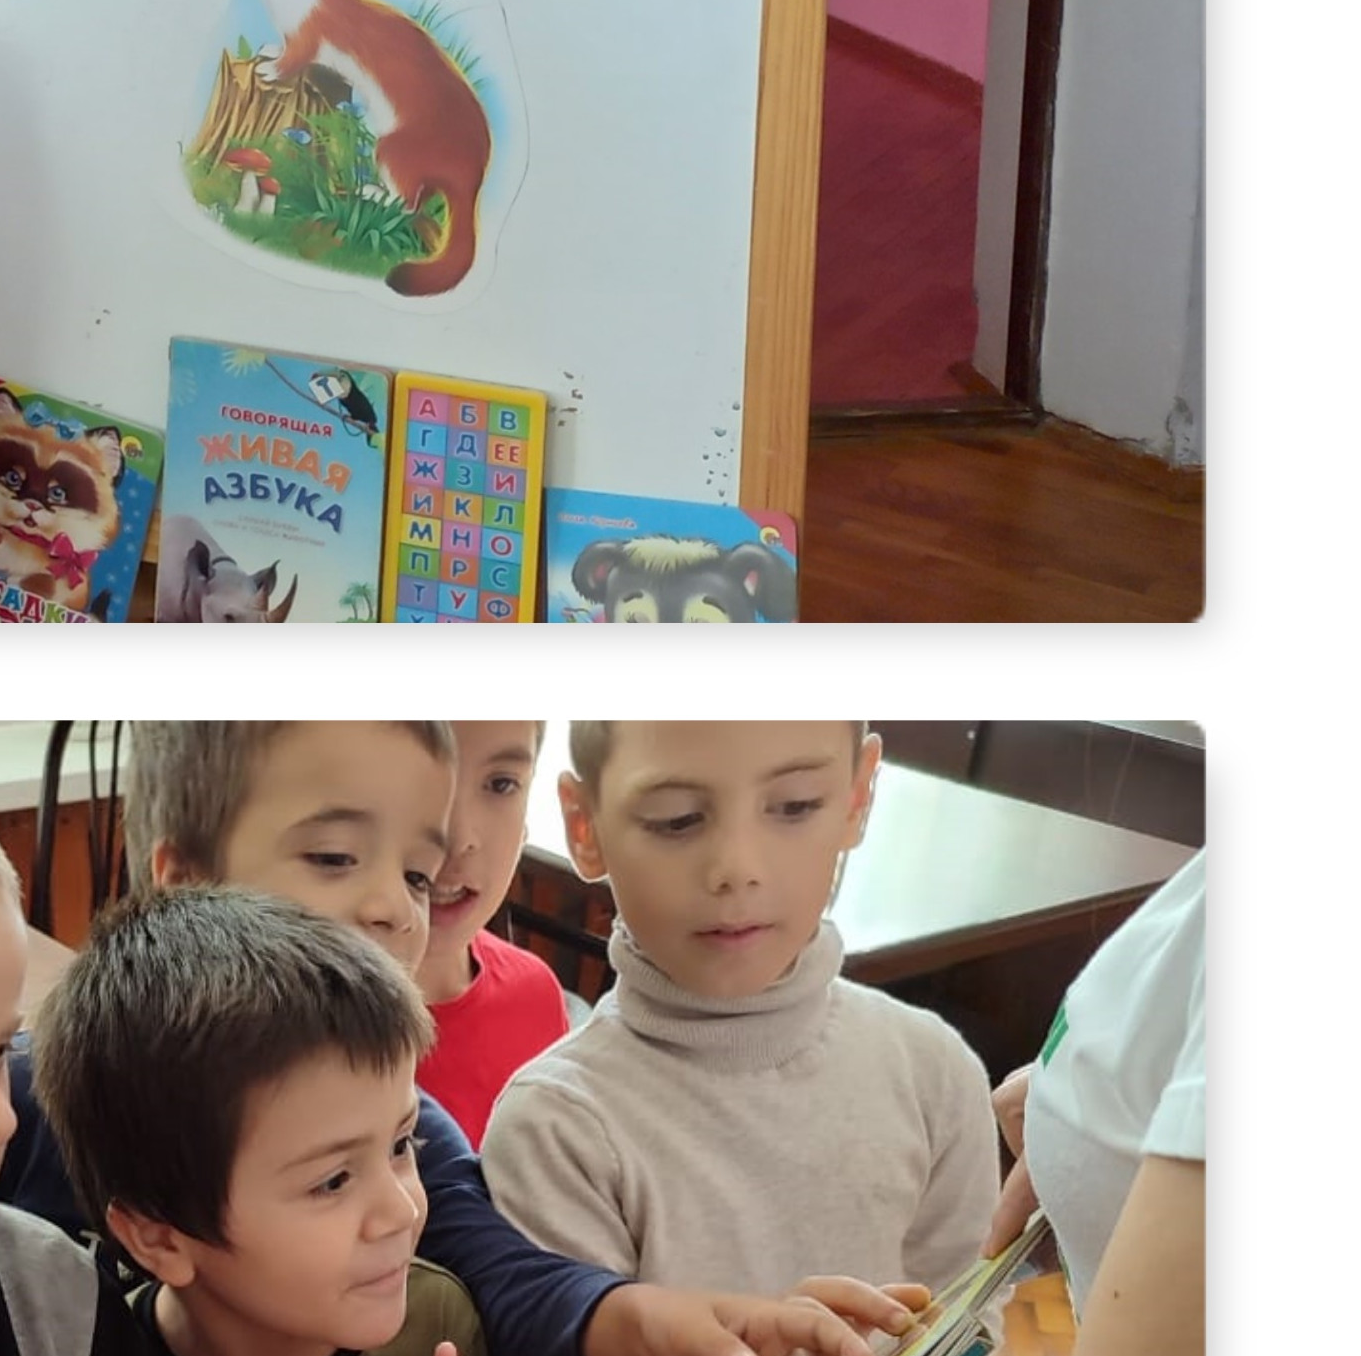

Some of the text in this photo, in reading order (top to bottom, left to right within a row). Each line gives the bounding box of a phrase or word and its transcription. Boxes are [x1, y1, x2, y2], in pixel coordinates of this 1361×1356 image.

[220, 406, 333, 437] ГОВОРЯЩАЯ
[419, 400, 517, 431] А Б В
[421, 429, 433, 447] Г
[456, 435, 476, 457] Д
[199, 433, 351, 493] ЖИВАЯ
[412, 459, 515, 493] Ж З И
[204, 472, 344, 533] АЗБУКА
[455, 497, 470, 517] К
[494, 504, 513, 525] Л
[409, 521, 512, 556] М Н О
[411, 551, 507, 587] П Р С
[413, 584, 511, 618] Т У Ф
